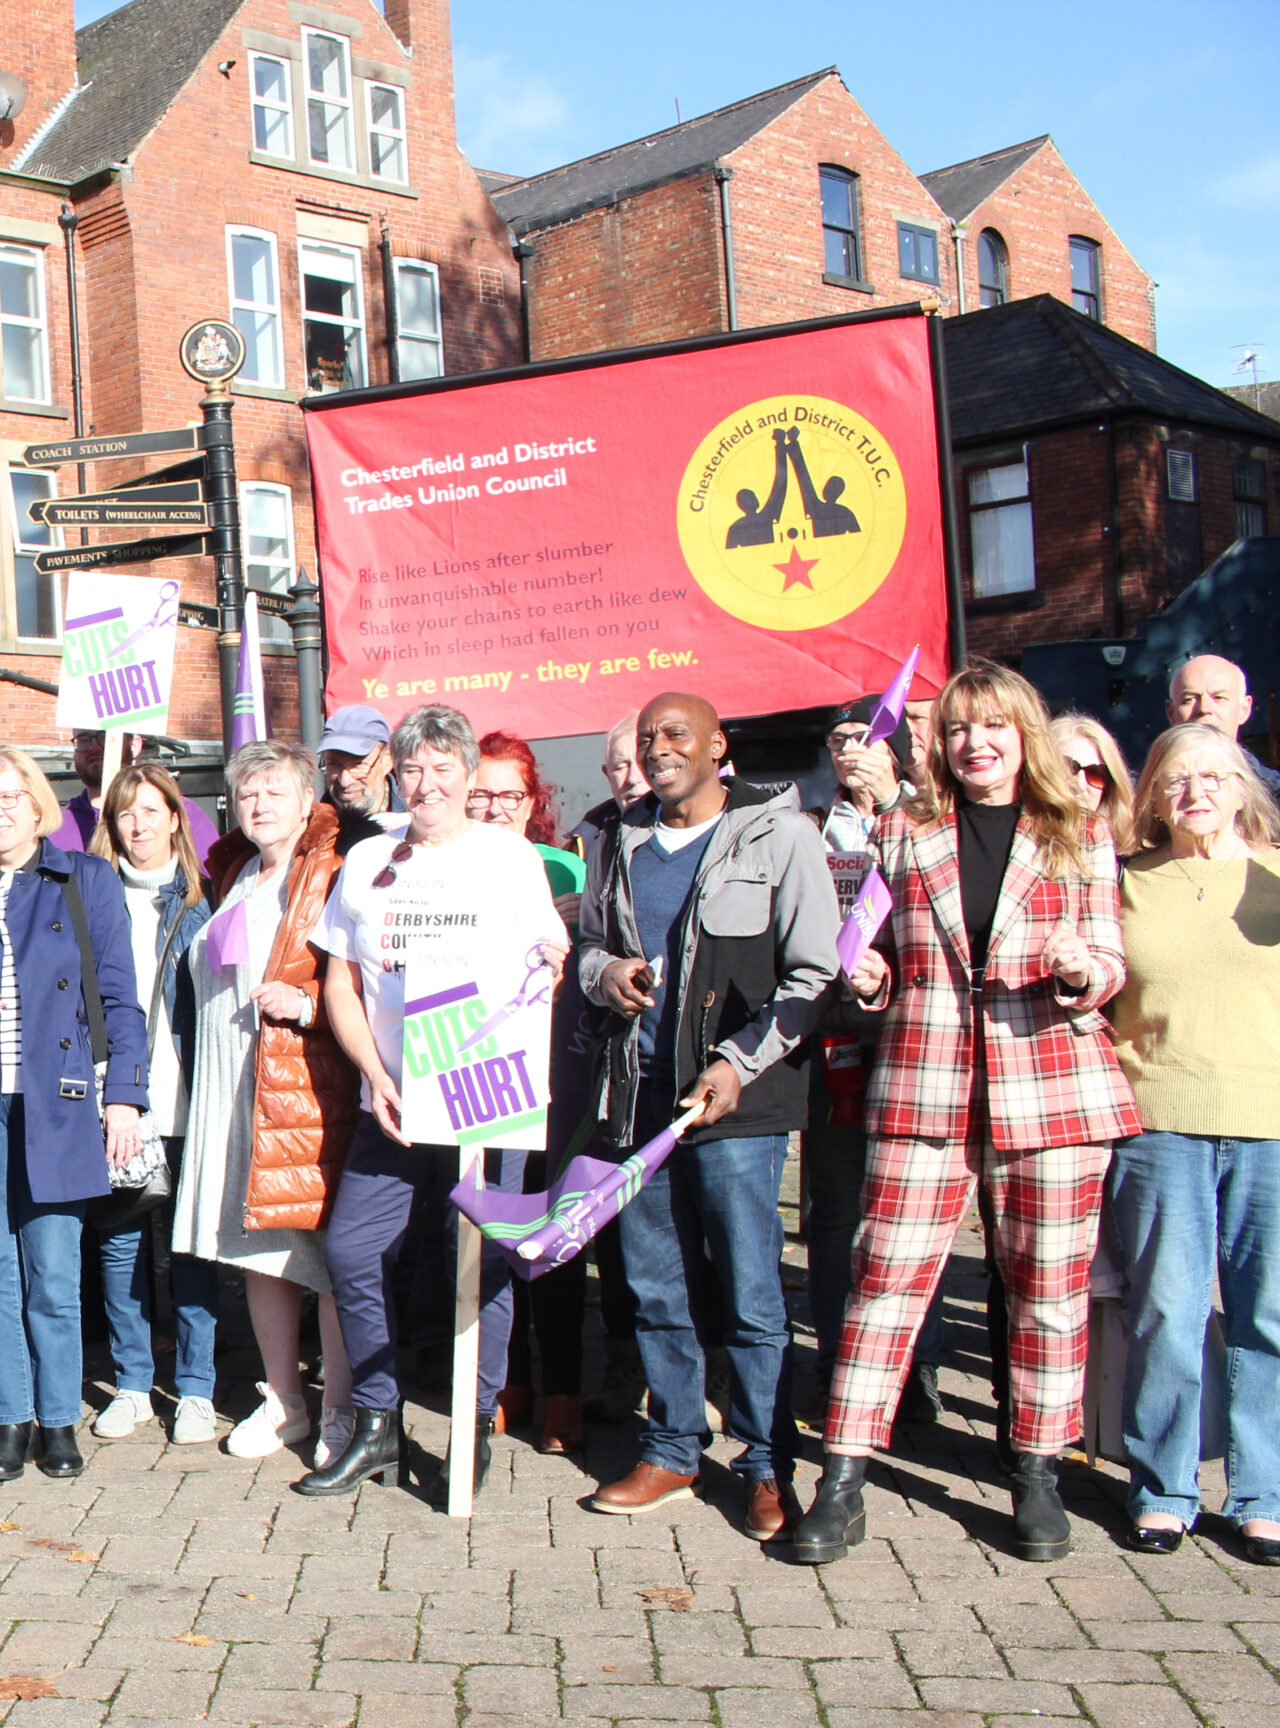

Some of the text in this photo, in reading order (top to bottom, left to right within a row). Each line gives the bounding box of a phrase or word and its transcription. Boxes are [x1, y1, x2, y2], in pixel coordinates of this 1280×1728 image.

[32, 441, 127, 460] COACH STATION
[341, 437, 597, 487] Chesterfield and District
[690, 407, 890, 512] Chesterfield and District T.U.C.
[344, 467, 567, 515] Trades Union Council
[55, 510, 100, 521] TOILETS
[105, 510, 167, 521] (WHEELCHAIR
[169, 510, 202, 521] ACCESS)
[46, 543, 168, 567] PAVEMENTS SHOPPING
[359, 541, 614, 584] Rise like Lions after slumber
[257, 596, 278, 609] EATRE
[359, 567, 604, 610] In unvanquishable number!
[359, 587, 688, 637] Shake your chains to earth like dew
[62, 620, 135, 678] CUTS
[362, 619, 660, 661] Which in sleep had fallen on you
[88, 659, 162, 719] HURT
[361, 678, 389, 699] Ye
[396, 679, 437, 697] are
[444, 670, 513, 692] many
[536, 659, 591, 683] they
[599, 656, 641, 675] are
[647, 648, 699, 670] few.
[384, 912, 478, 928] DERBYSHIRE
[403, 999, 498, 1079] CUTS
[437, 1049, 538, 1131] HURT
